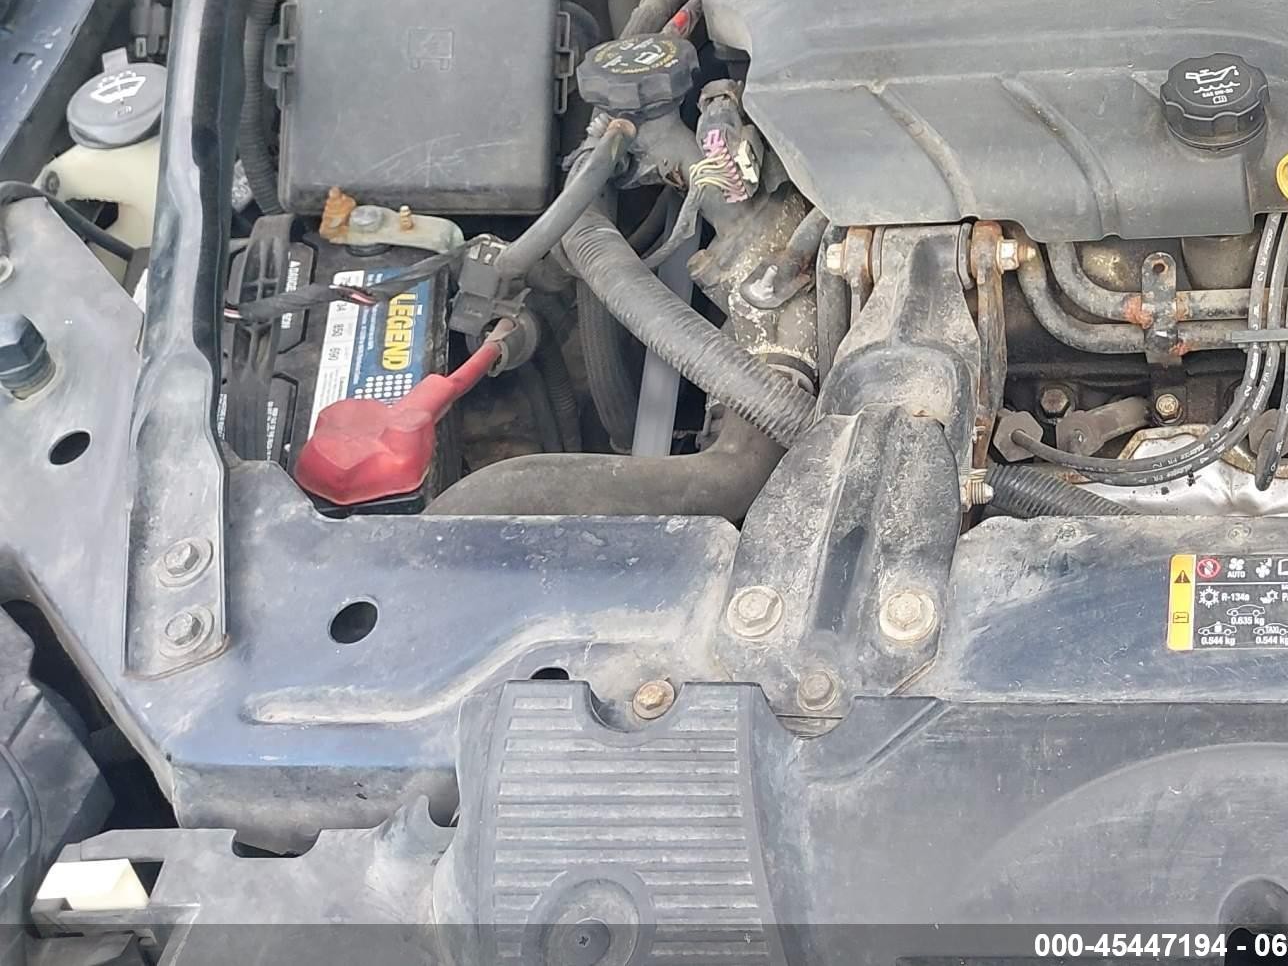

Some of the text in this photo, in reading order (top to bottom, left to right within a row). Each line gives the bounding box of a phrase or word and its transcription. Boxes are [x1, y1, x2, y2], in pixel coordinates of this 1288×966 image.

[382, 293, 417, 371] LEGEND
[1254, 616, 1265, 626] kg
[1225, 636, 1236, 646] kg
[1255, 636, 1278, 645] 0.544
